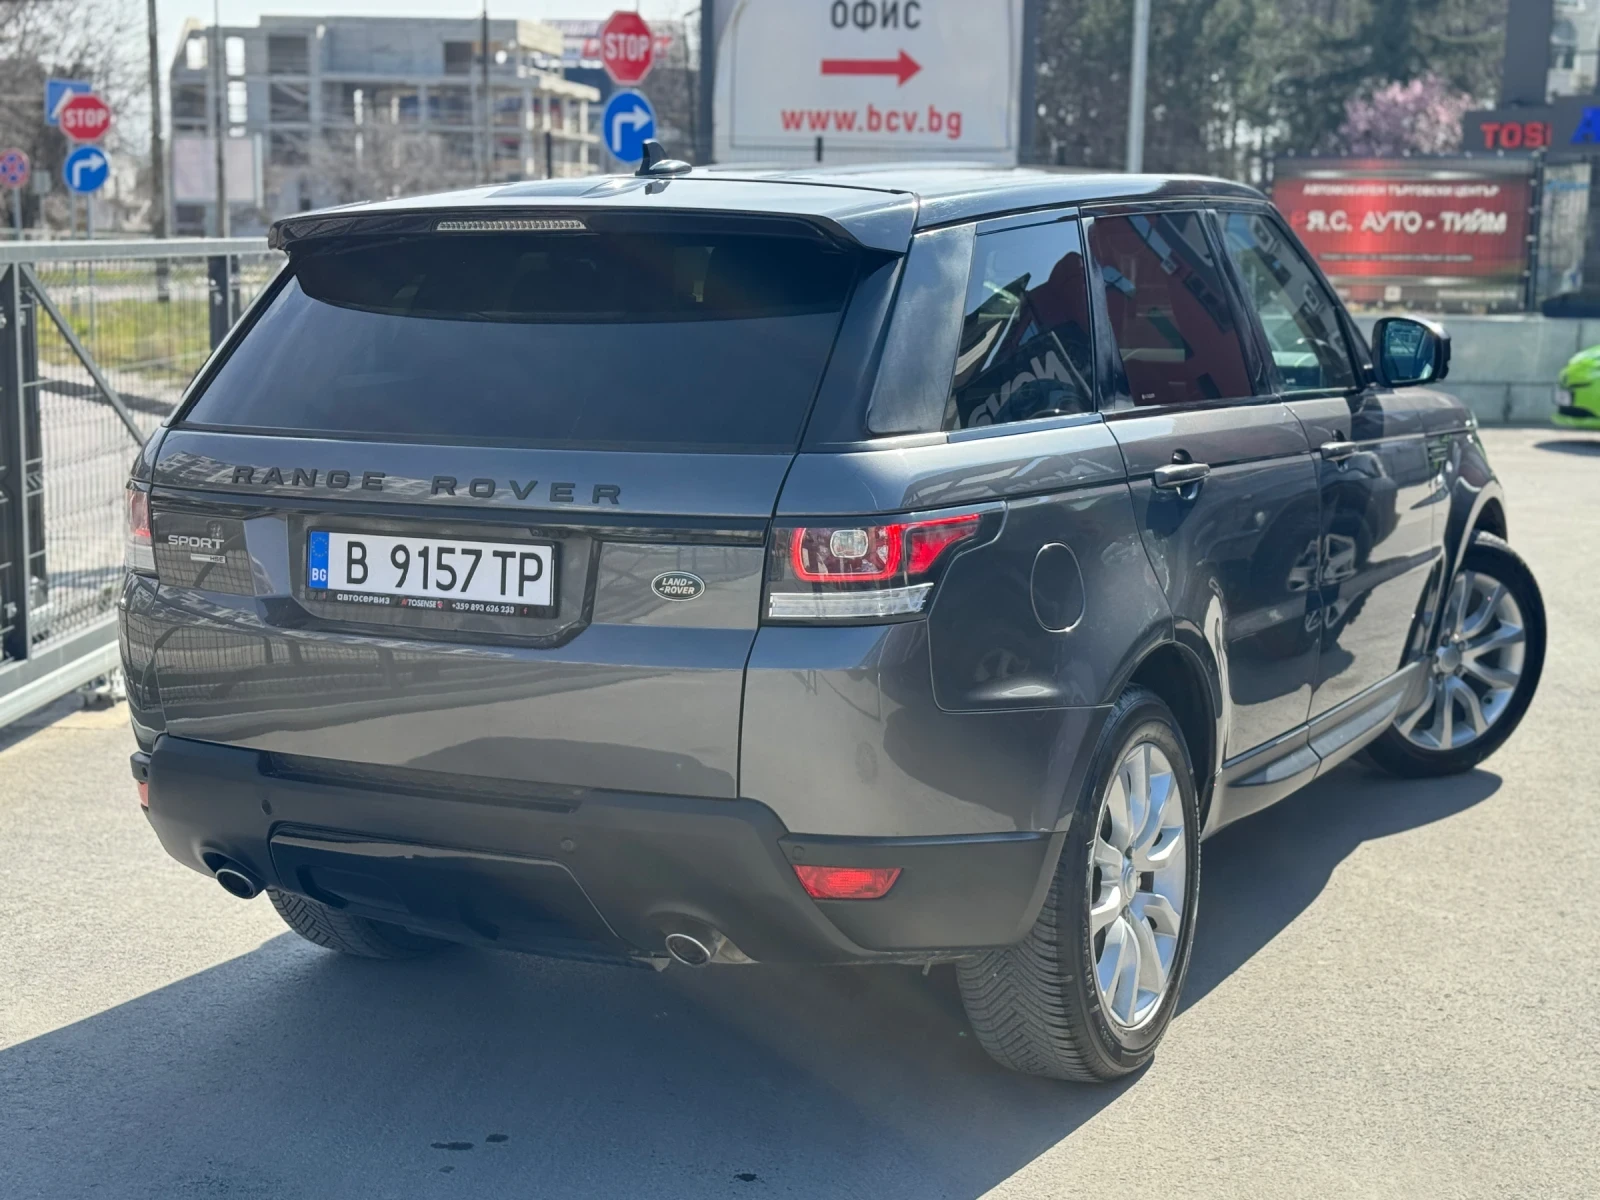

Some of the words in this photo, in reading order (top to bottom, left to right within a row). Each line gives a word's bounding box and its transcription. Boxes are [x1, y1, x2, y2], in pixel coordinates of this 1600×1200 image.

[831, 0, 922, 31] ОФИС
[604, 33, 650, 61] STOP
[64, 107, 107, 129] STOP
[780, 103, 963, 139] www.bcv.bg
[1306, 210, 1353, 233] Я.С.
[1360, 210, 1423, 234] АУТО
[231, 465, 386, 492] RANGE
[430, 475, 622, 505] ROVER
[168, 534, 225, 549] SPORT
[311, 567, 327, 582] BG
[346, 541, 369, 585] B
[390, 544, 483, 592] 9157
[492, 550, 543, 597] TP
[662, 577, 688, 586] LAND
[664, 585, 696, 595] ROVER
[337, 593, 390, 605] автосервиз
[452, 602, 469, 611] +359
[470, 603, 485, 612] 893
[485, 604, 500, 613] 626
[500, 605, 515, 614] 233
